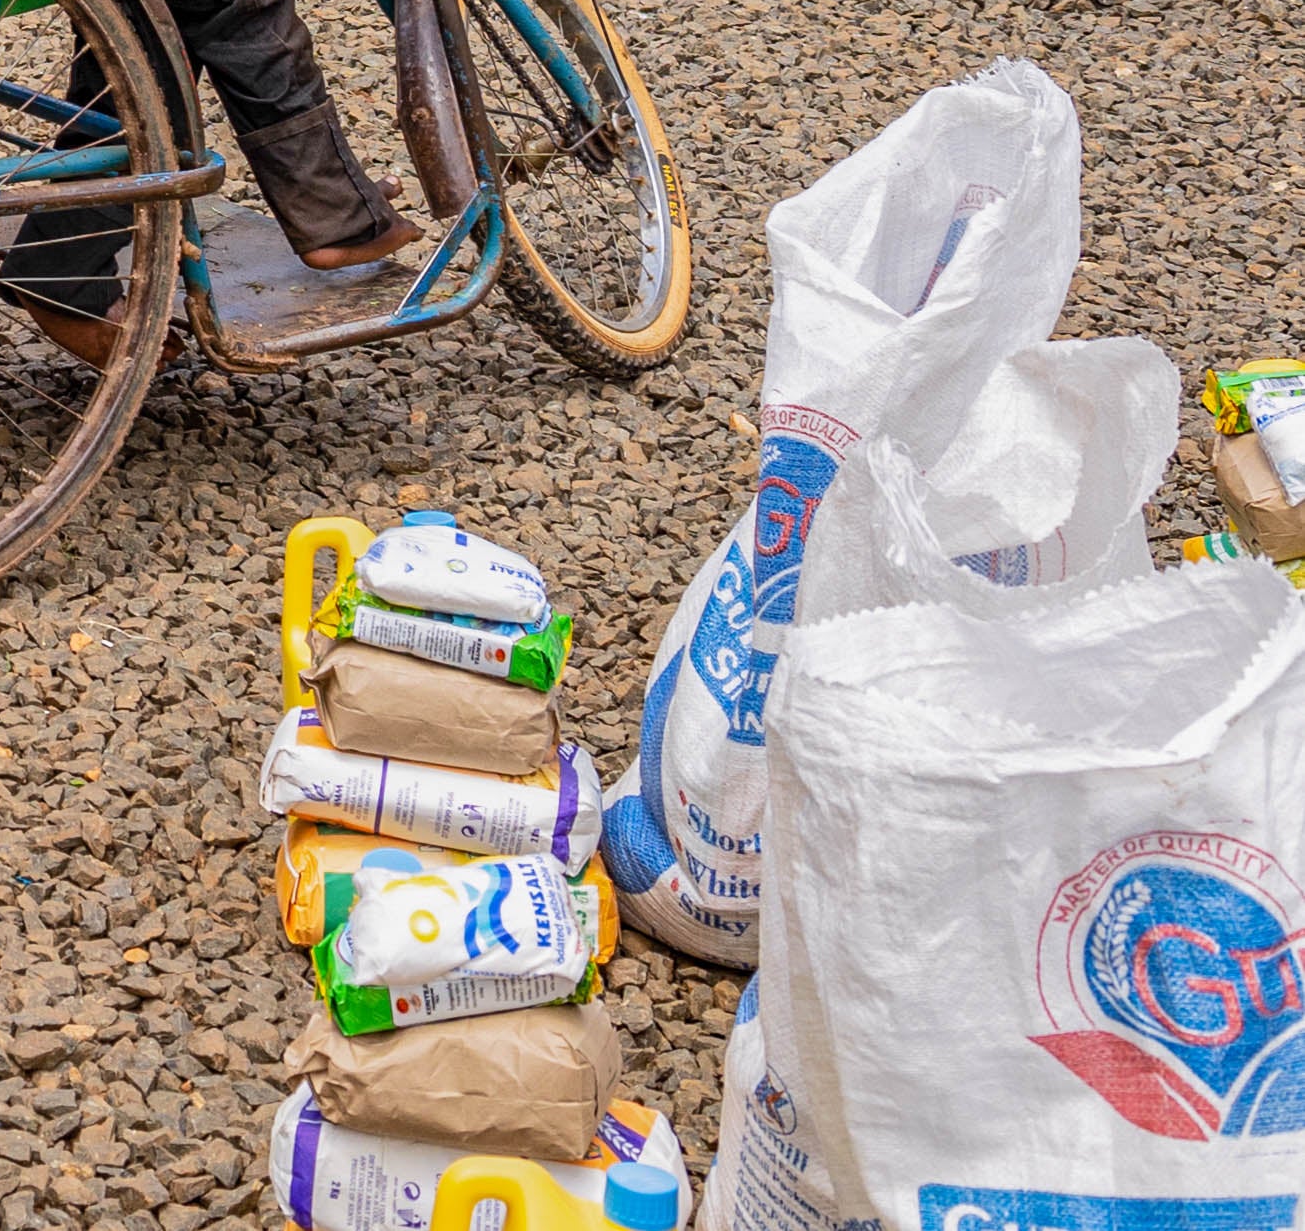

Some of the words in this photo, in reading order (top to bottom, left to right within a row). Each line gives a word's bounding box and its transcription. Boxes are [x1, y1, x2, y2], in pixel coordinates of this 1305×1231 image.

[779, 410, 797, 424] OF
[799, 414, 857, 449] QUALIT
[1053, 849, 1122, 923] MASTER
[1123, 838, 1150, 855] OF
[1157, 835, 1272, 880] QUALITY
[554, 924, 566, 965] odated
[1133, 921, 1305, 1047] Gu
